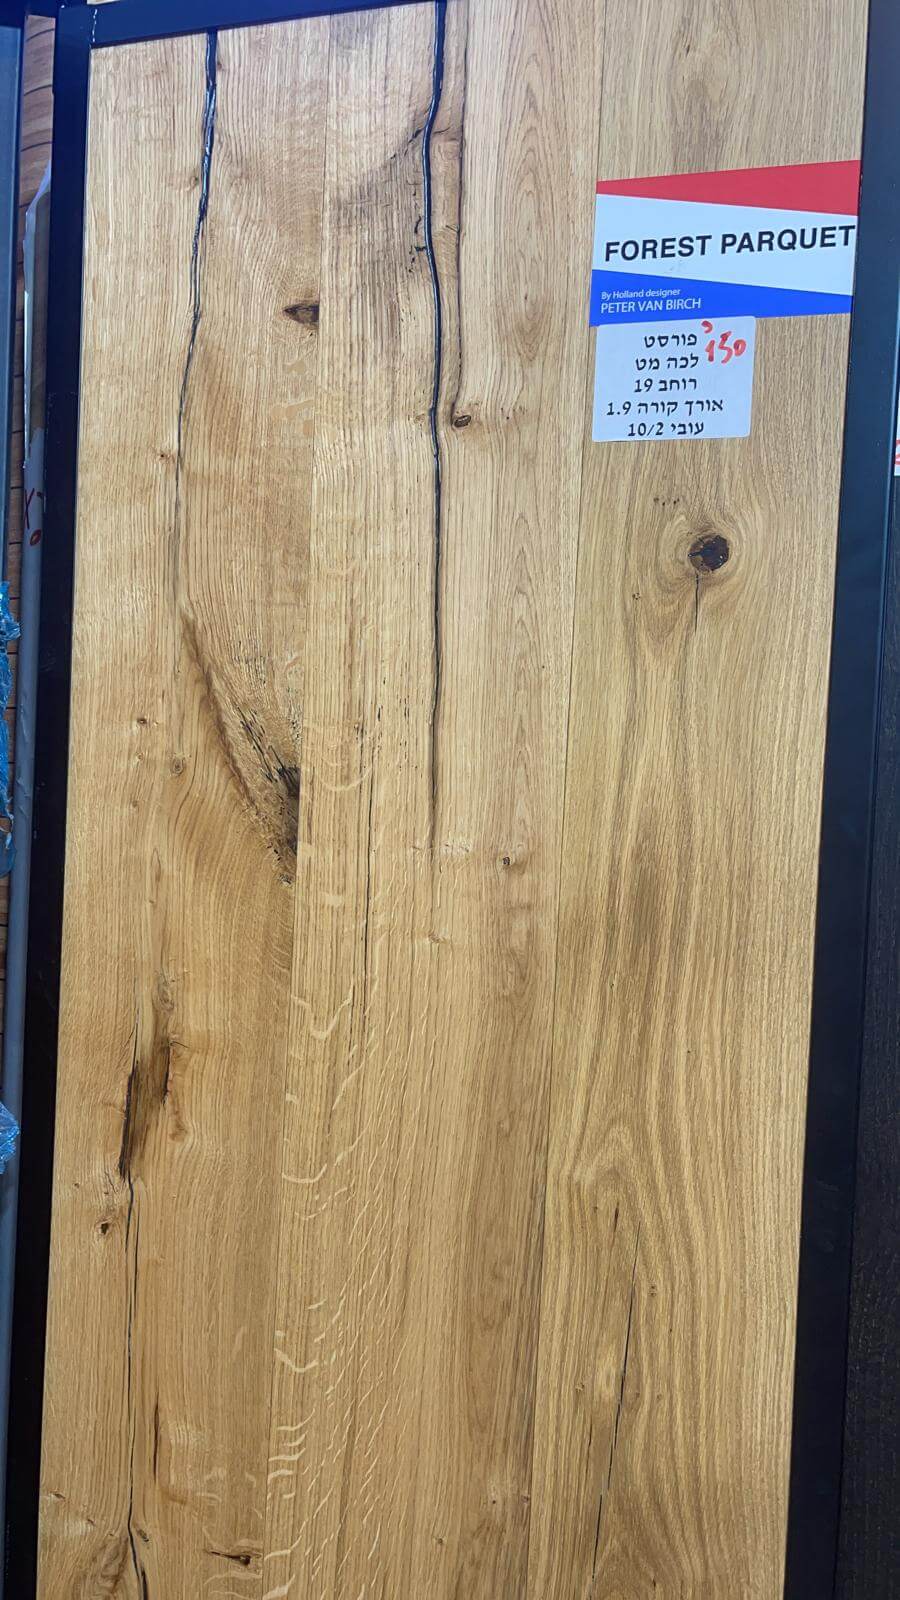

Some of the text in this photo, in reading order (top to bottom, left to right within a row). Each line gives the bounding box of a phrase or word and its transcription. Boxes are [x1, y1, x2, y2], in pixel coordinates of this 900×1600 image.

[604, 224, 856, 262] FOREST PARQUET
[601, 287, 681, 300] By Holland designer
[601, 298, 701, 313] PETER VAN BIRCH
[644, 333, 698, 348] פורסט
[636, 353, 699, 371] לכה מט
[634, 378, 698, 393] רוחב 19
[607, 399, 724, 417] אורך קורה 1.9
[628, 422, 704, 437] עובי 10/2
